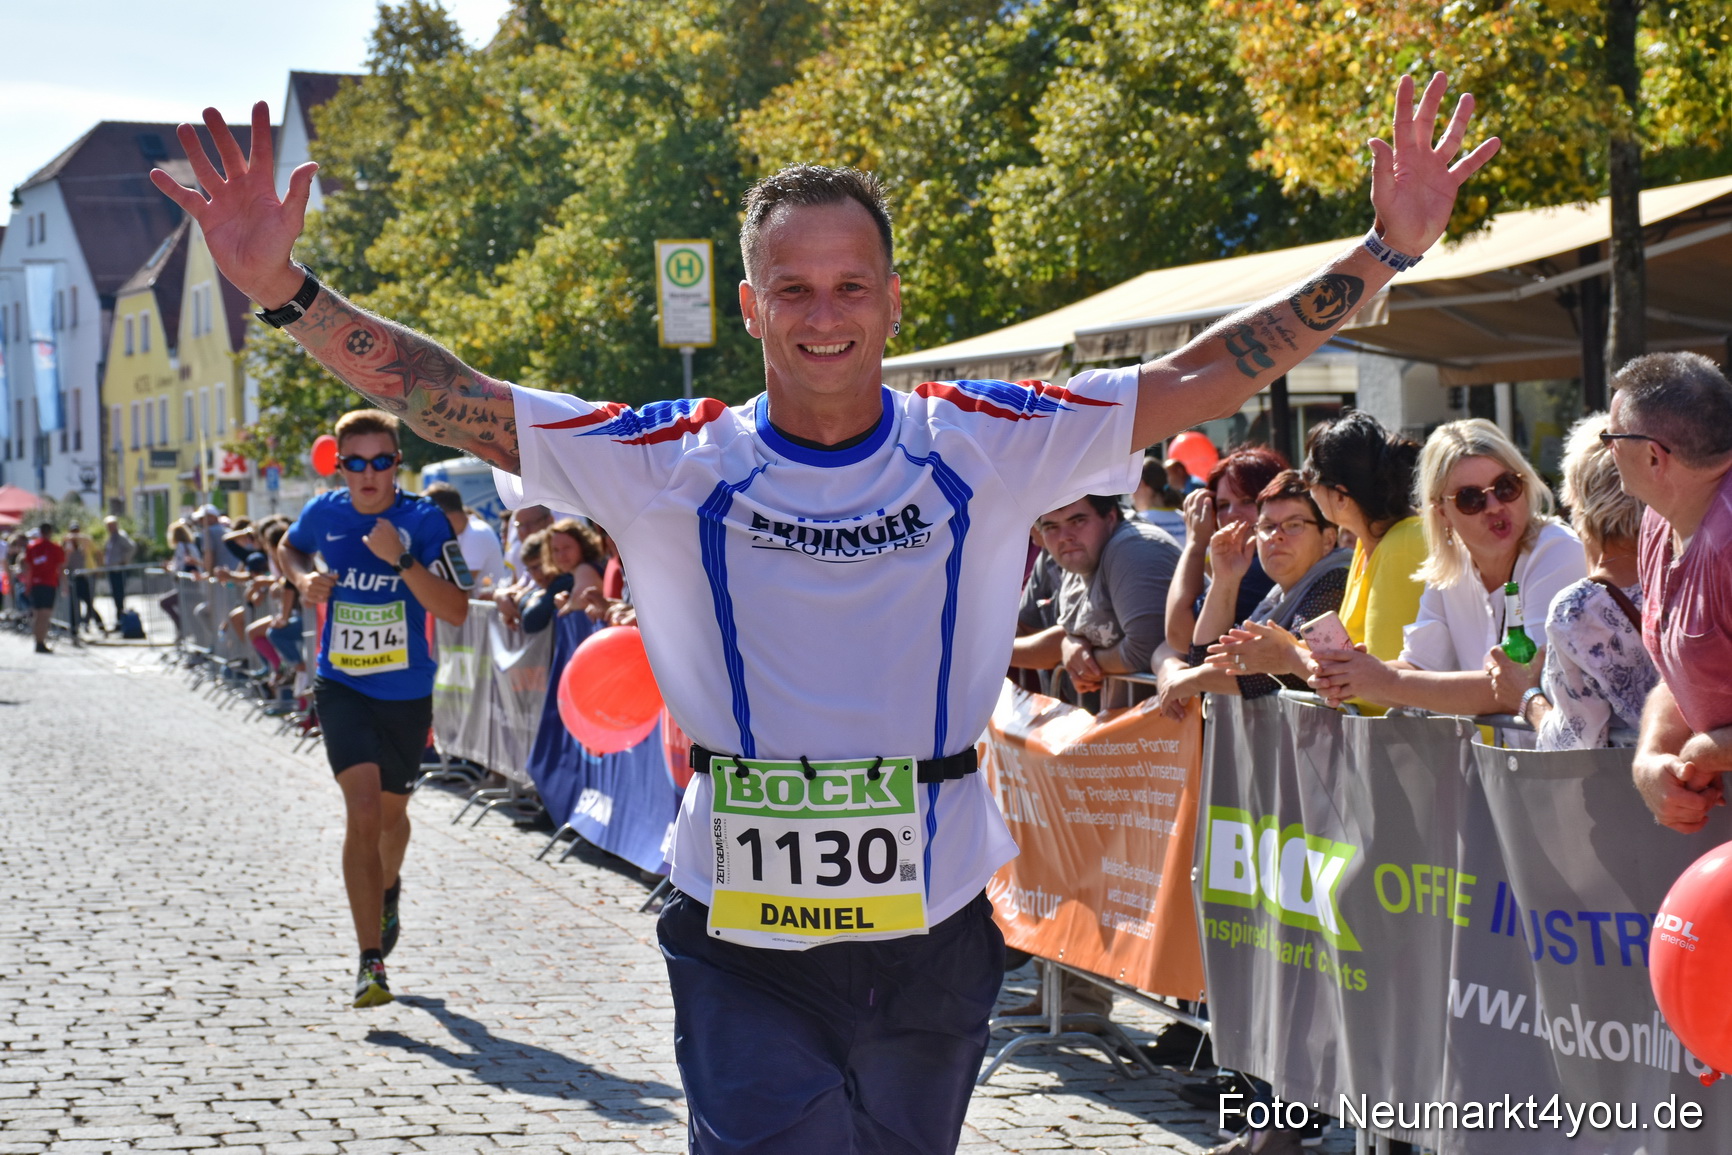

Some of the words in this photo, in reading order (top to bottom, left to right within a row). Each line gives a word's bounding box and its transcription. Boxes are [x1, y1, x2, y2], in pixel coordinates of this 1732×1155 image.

[675, 257, 694, 279] H
[751, 504, 933, 549] ERDINGER
[338, 606, 397, 623] BOCK
[341, 628, 397, 651] 1214
[341, 655, 394, 667] MICHAEL
[1089, 738, 1138, 756] moderner
[1138, 737, 1180, 754] Partner
[1068, 763, 1123, 783] Konzeption
[1124, 760, 1144, 778] und
[726, 767, 899, 810] BOCK
[1086, 785, 1131, 806] Projekte
[736, 827, 898, 887] 1130
[1207, 817, 1348, 937] BOCK
[760, 903, 874, 930] DANIEL
